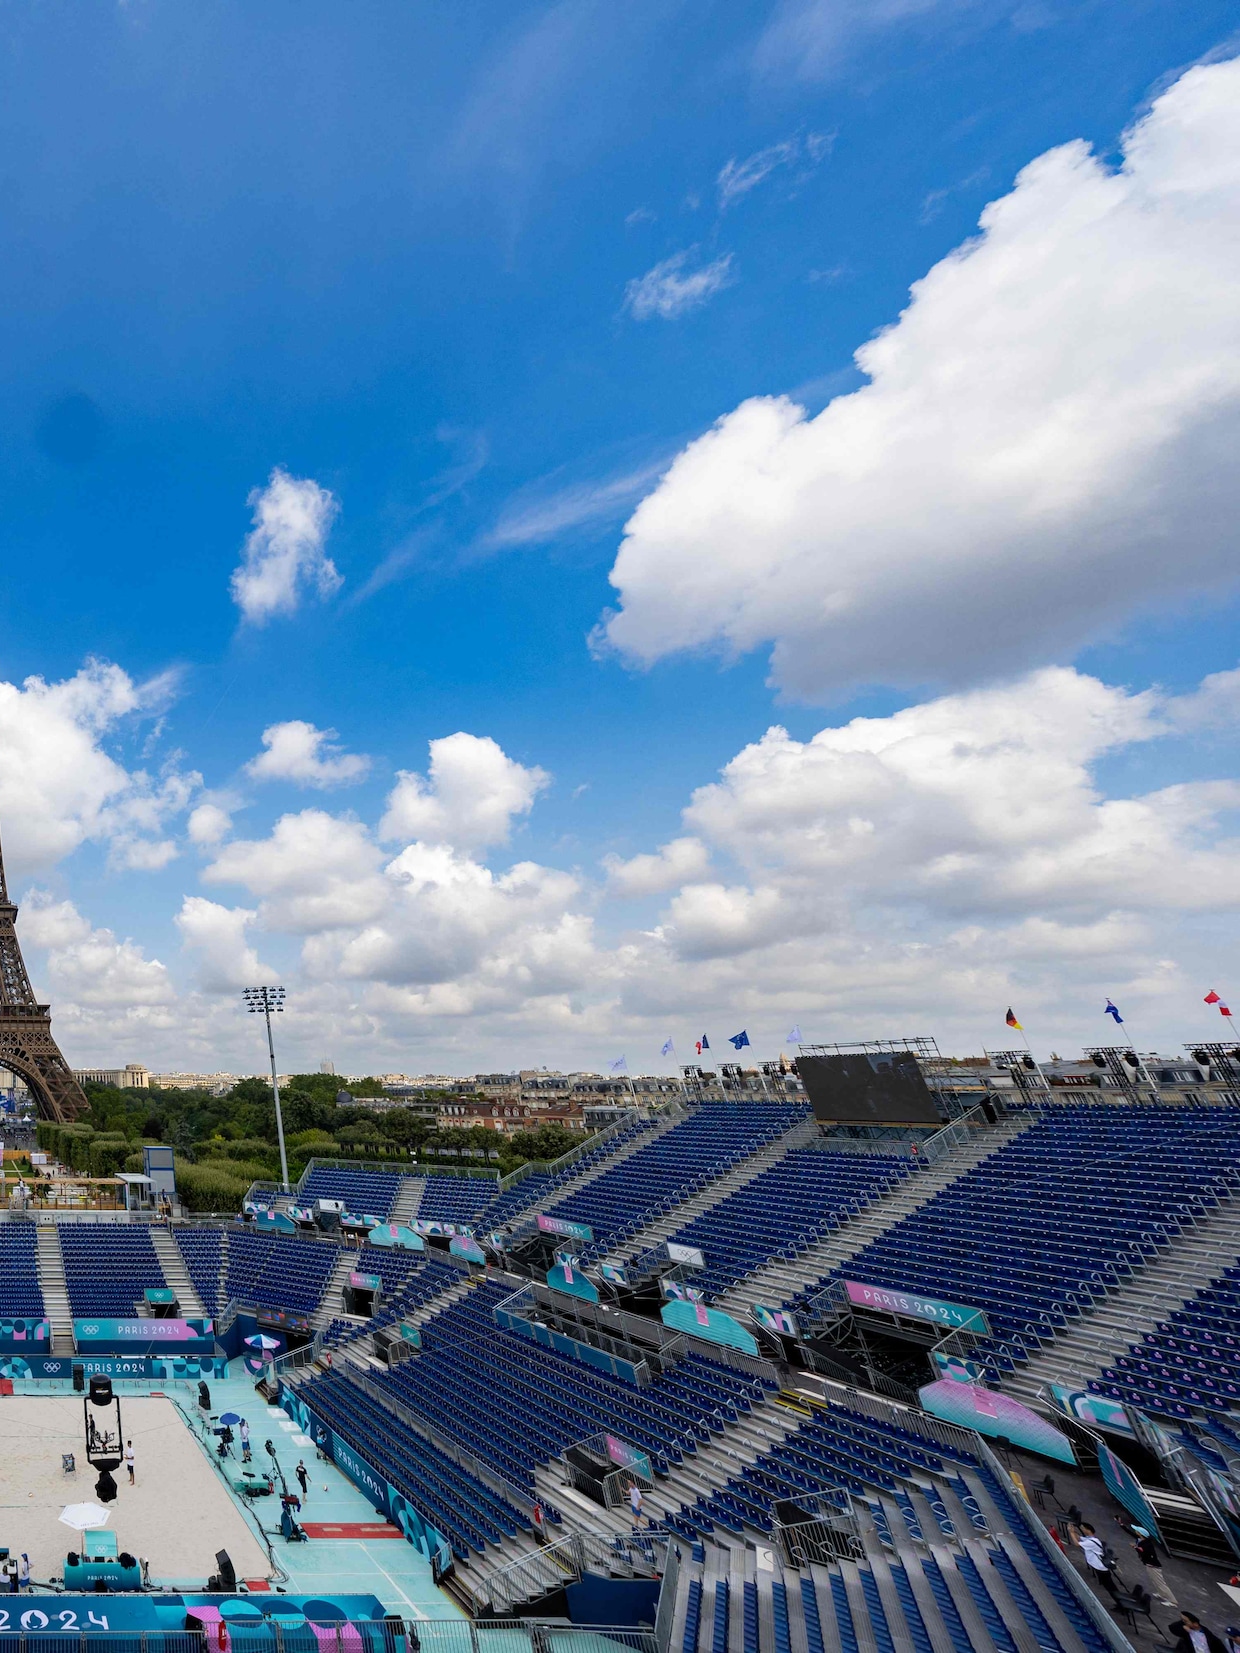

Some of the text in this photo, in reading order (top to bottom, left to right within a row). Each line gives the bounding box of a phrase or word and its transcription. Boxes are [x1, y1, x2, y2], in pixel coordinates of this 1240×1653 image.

[914, 1301, 963, 1323] 2024
[151, 1325, 180, 1335] 2024
[116, 1363, 145, 1373] 2024
[361, 1470, 385, 1501] 2024
